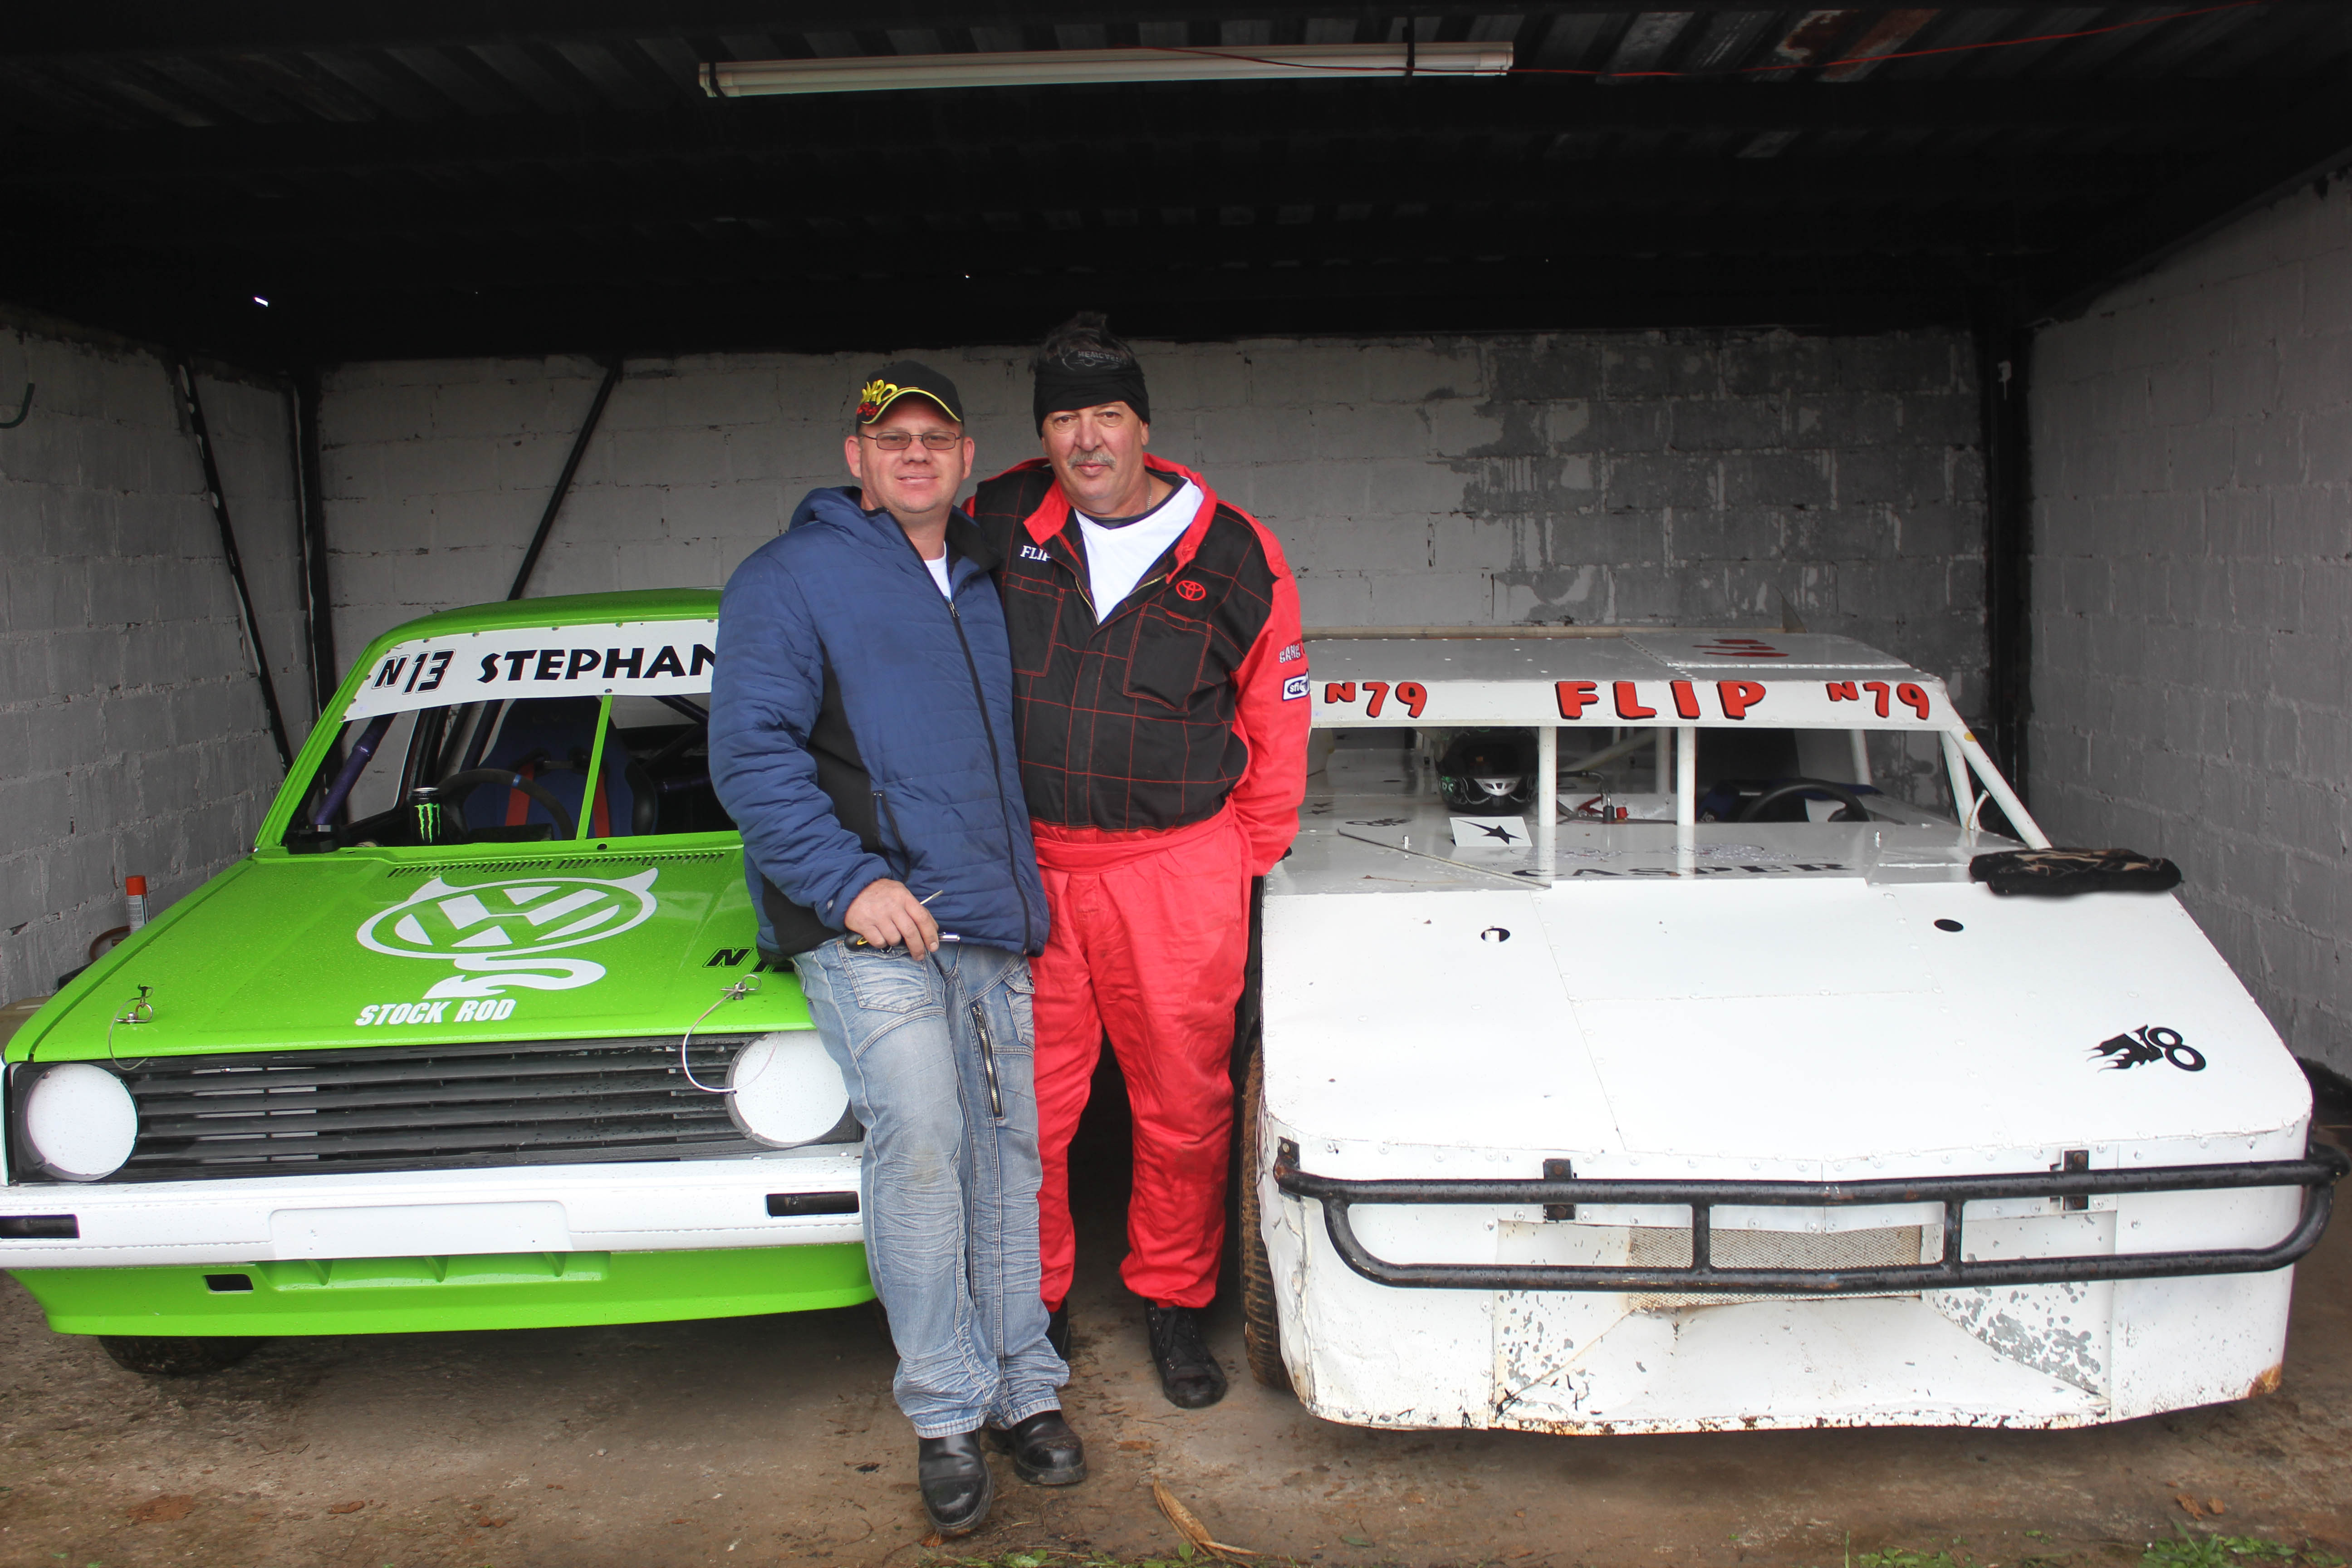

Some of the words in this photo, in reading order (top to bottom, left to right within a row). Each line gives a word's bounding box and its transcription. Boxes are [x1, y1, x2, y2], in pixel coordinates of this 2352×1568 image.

[1556, 681, 1766, 720] FLIP
[355, 1000, 452, 1026] STOCK
[454, 999, 517, 1023] ROD
